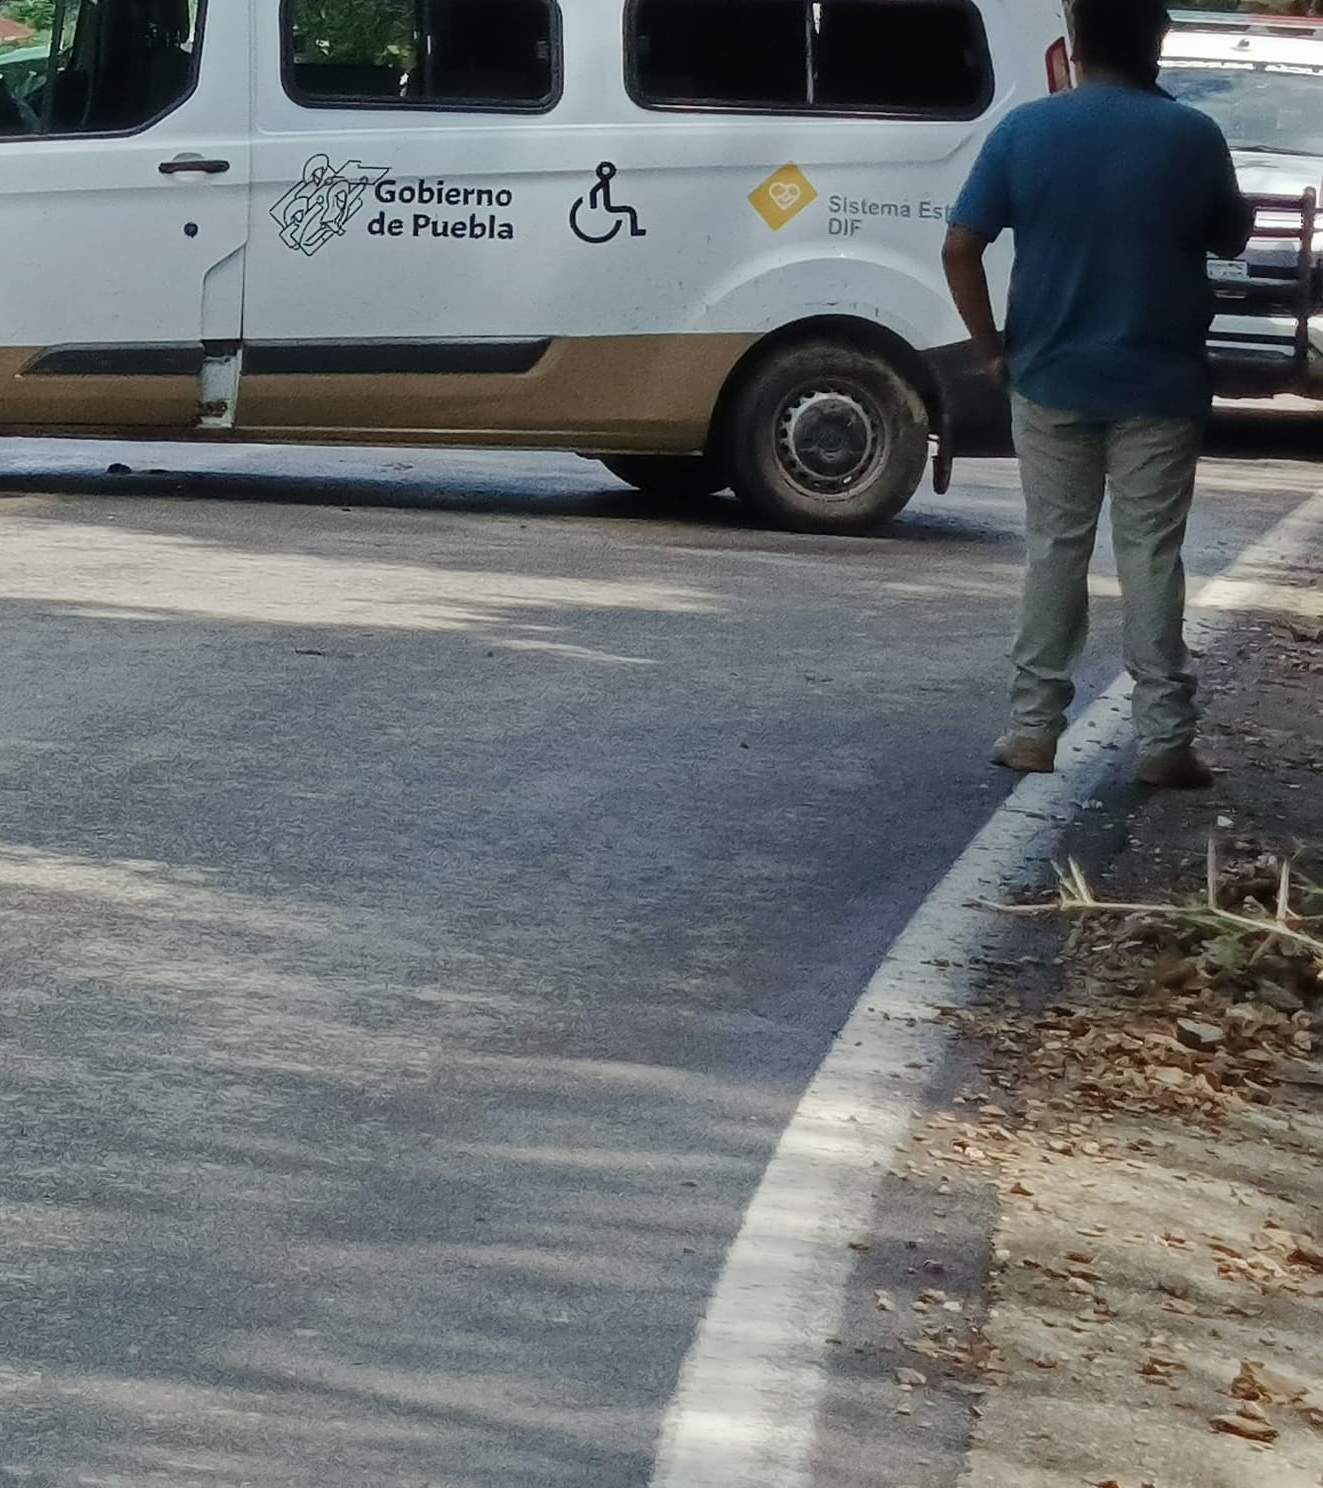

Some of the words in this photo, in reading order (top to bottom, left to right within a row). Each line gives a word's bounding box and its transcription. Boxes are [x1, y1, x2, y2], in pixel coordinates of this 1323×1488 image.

[374, 179, 513, 207] Gobierno
[828, 195, 911, 218] Sistema
[919, 201, 955, 223] Est
[367, 211, 404, 237] de
[412, 213, 514, 240] Puebla
[828, 217, 863, 236] DIF
